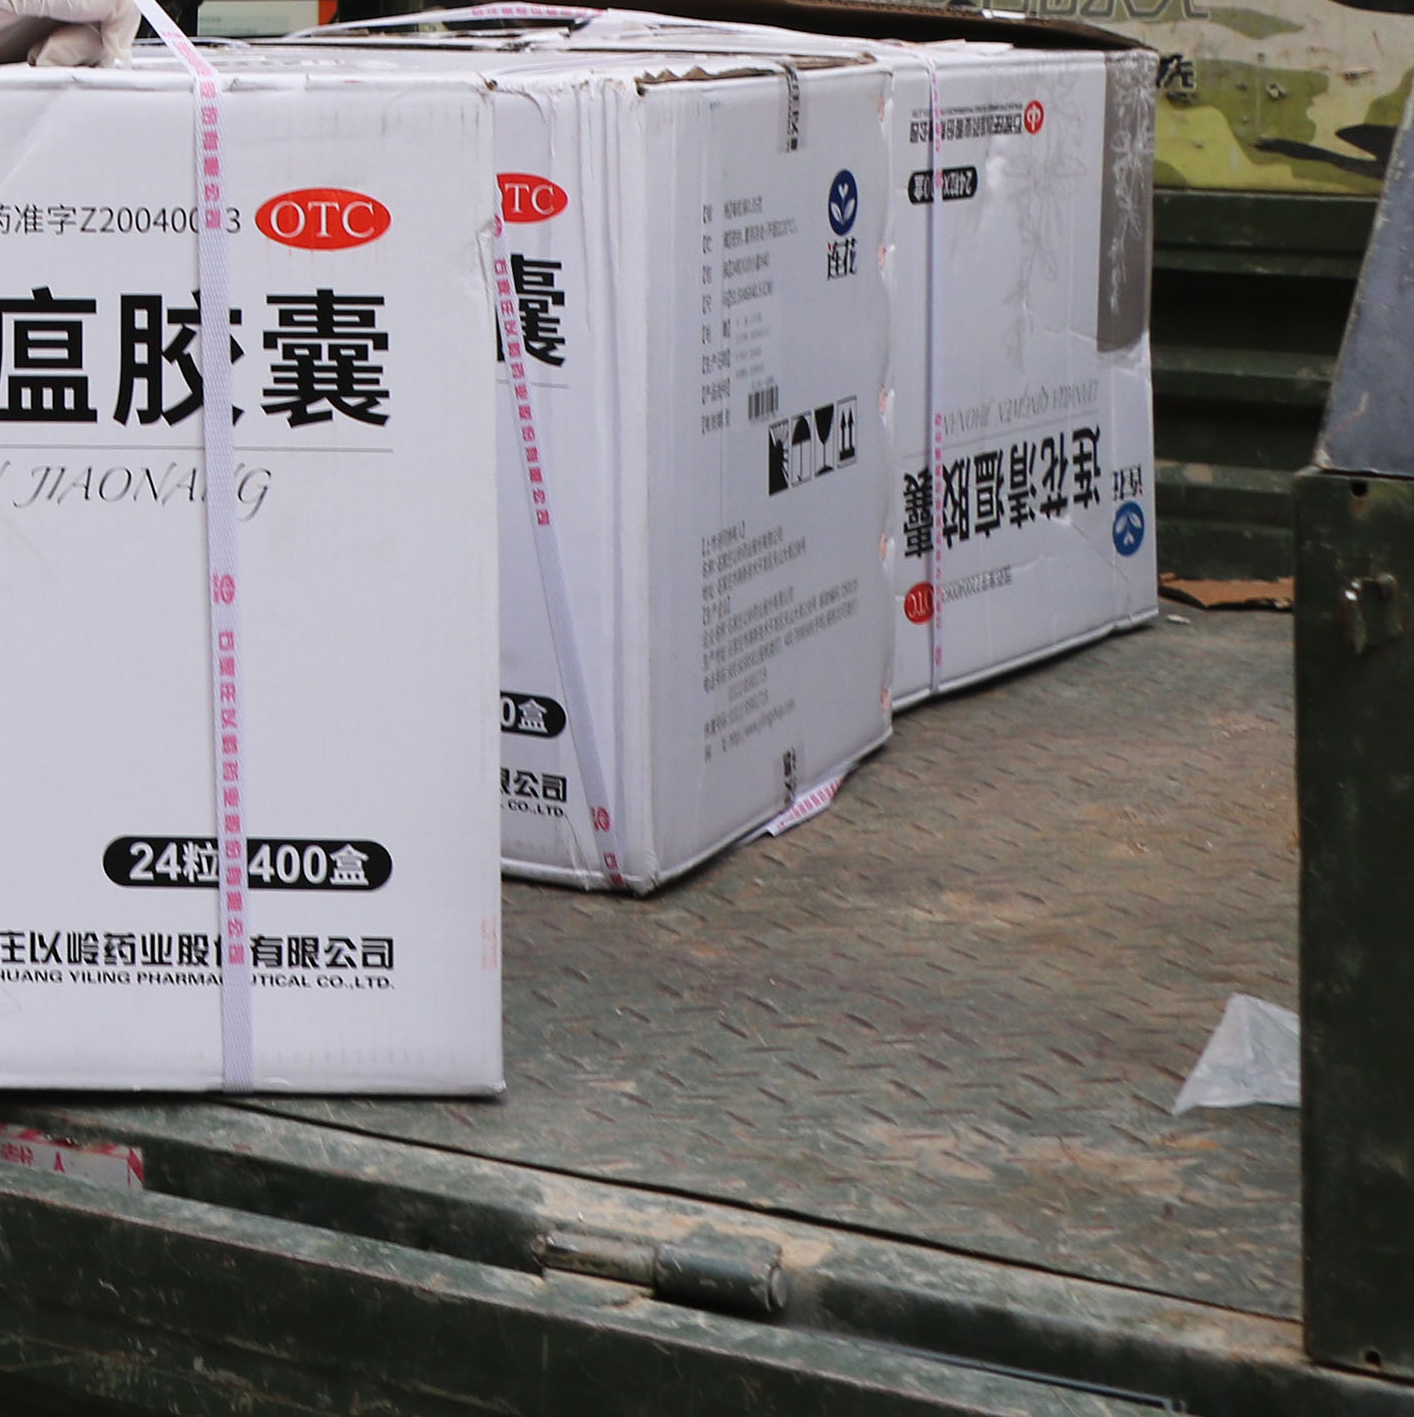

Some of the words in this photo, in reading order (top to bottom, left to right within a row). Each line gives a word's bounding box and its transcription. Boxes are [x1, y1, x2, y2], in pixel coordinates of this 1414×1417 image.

[270, 199, 377, 241] OTC
[502, 182, 555, 215] TC
[826, 237, 859, 281] 连花
[14, 462, 273, 521] JIAONAG
[902, 424, 1102, 560] 连花清瘟胶囊
[128, 842, 370, 887] 24粒400盒
